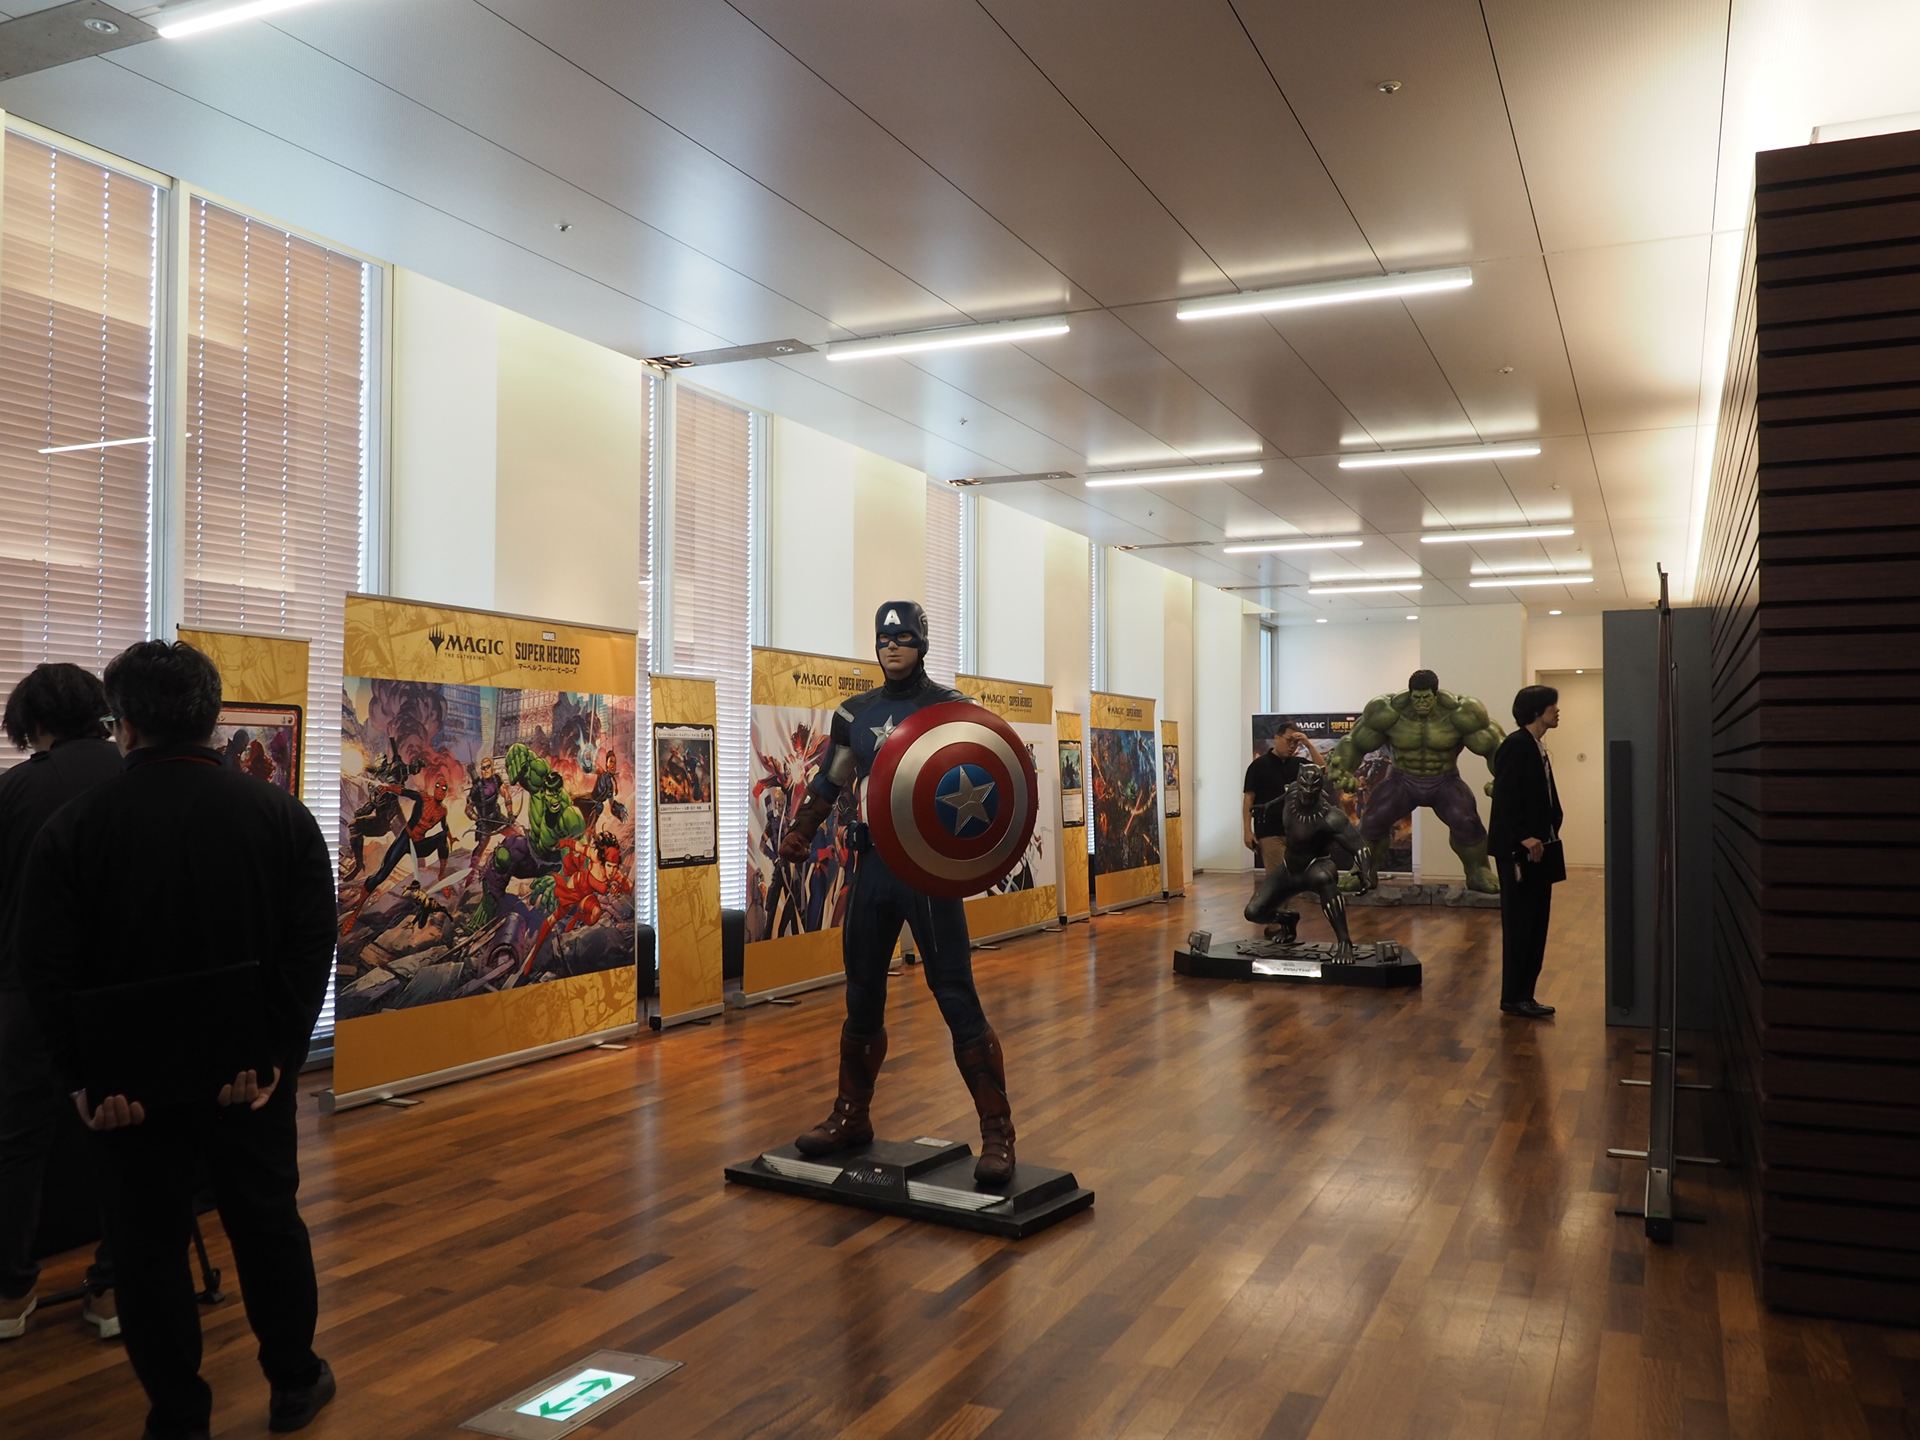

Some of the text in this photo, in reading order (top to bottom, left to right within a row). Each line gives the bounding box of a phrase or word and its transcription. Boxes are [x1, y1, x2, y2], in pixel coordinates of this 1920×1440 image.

[883, 608, 901, 626] A
[445, 634, 504, 656] MAGIC
[515, 642, 580, 665] SUPER HEROES
[801, 673, 832, 687] MAGIC
[838, 677, 855, 690] SUPER
[986, 693, 1006, 704] MAGIC
[1295, 721, 1325, 729] MAGIC
